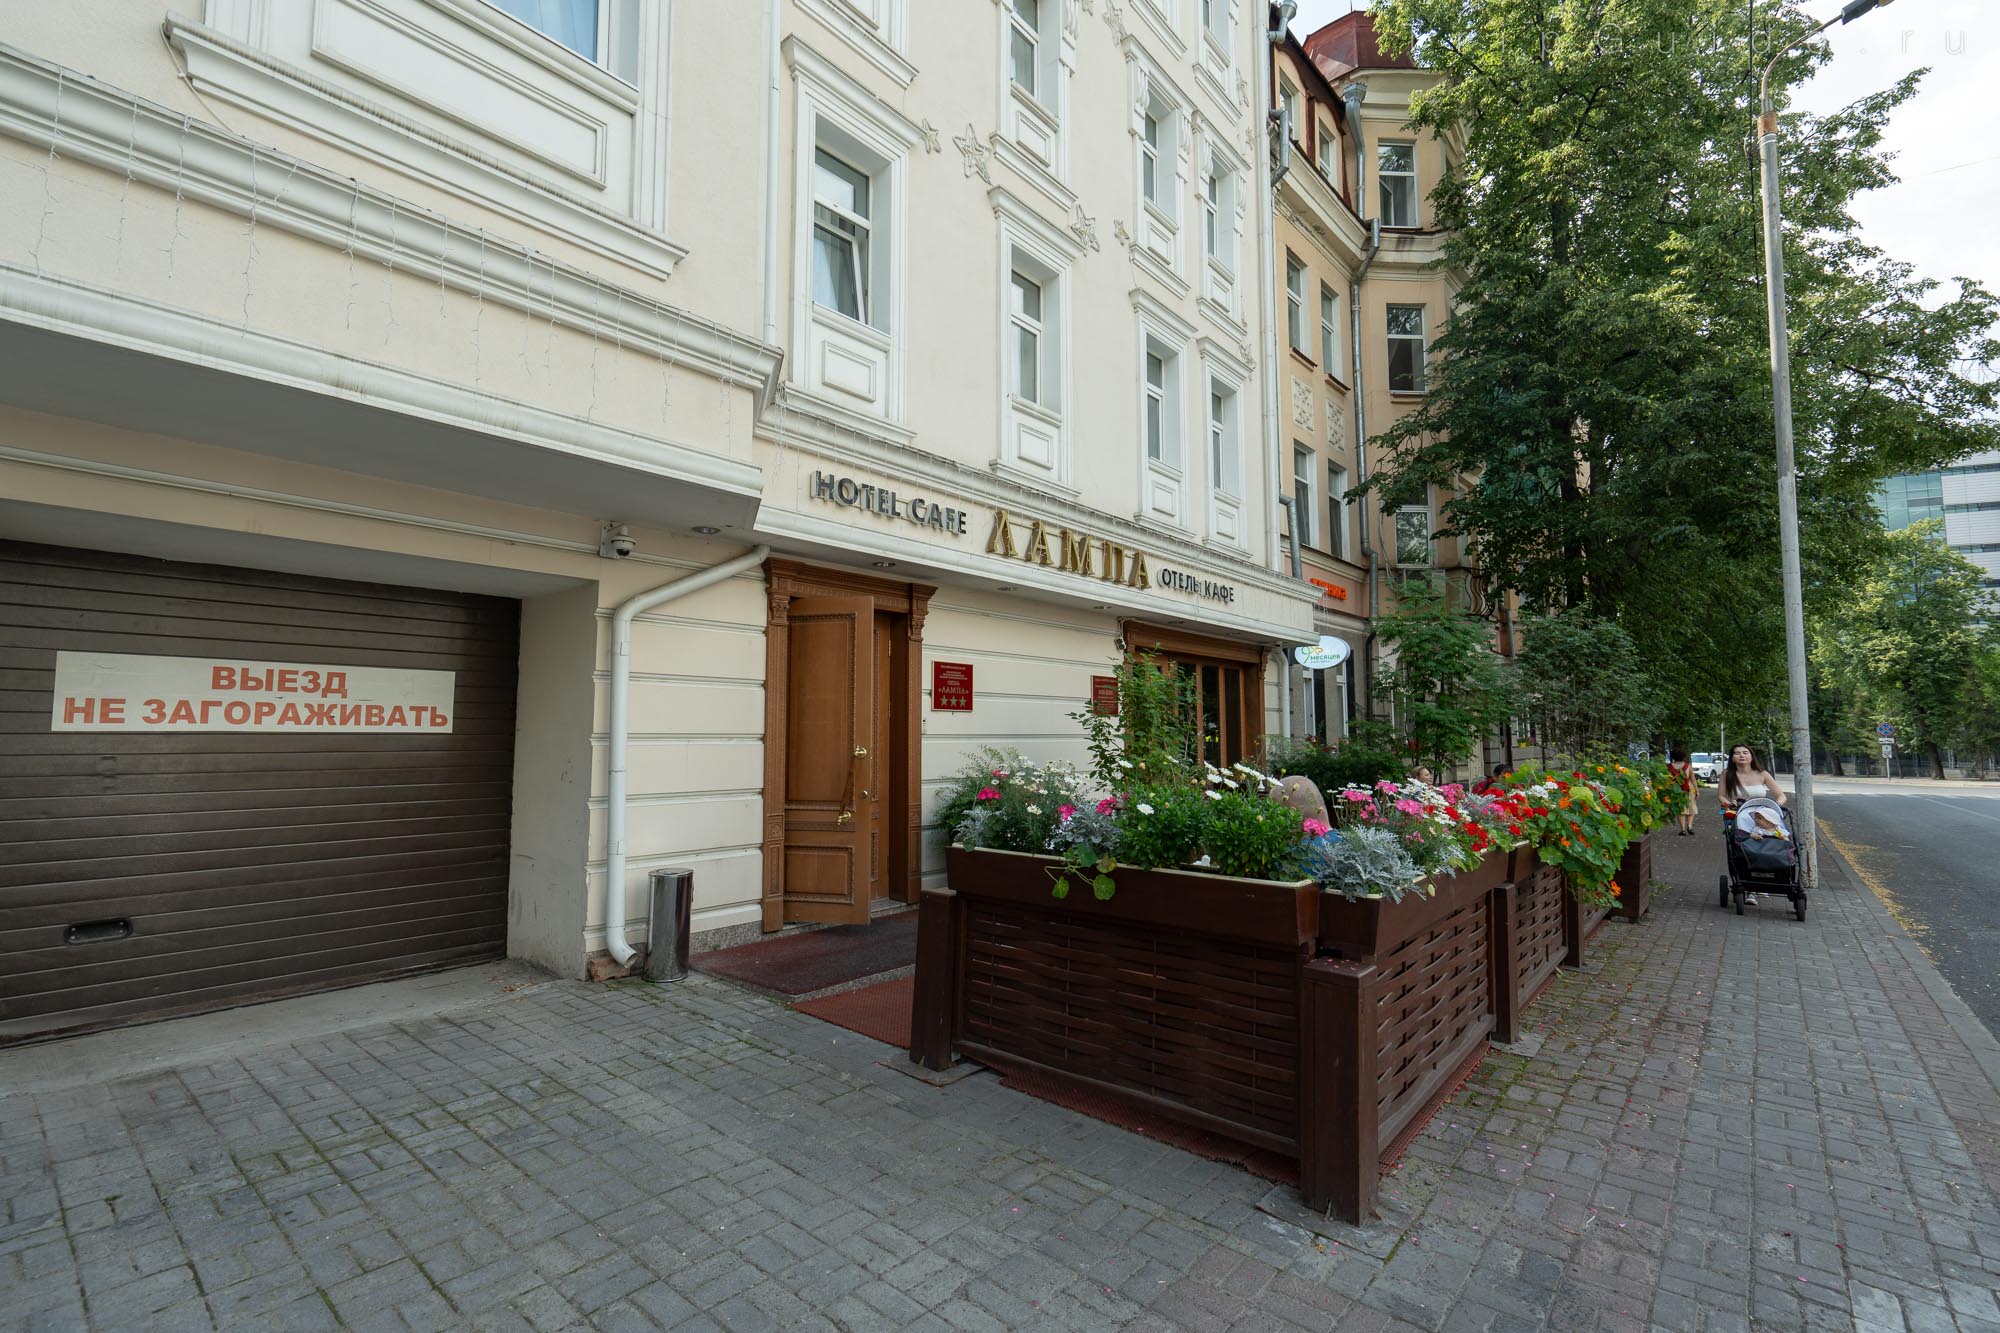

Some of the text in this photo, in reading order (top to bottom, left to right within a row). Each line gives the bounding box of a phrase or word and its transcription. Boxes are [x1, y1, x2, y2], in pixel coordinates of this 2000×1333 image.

[810, 470, 967, 535] HOTEL CAFE
[1157, 568, 1235, 604] ОТЕЛЬ КАФЕ
[211, 666, 347, 697] ВЫЕЗД
[63, 697, 448, 727] НЕ ЗАГОРАЖИВАТЬ
